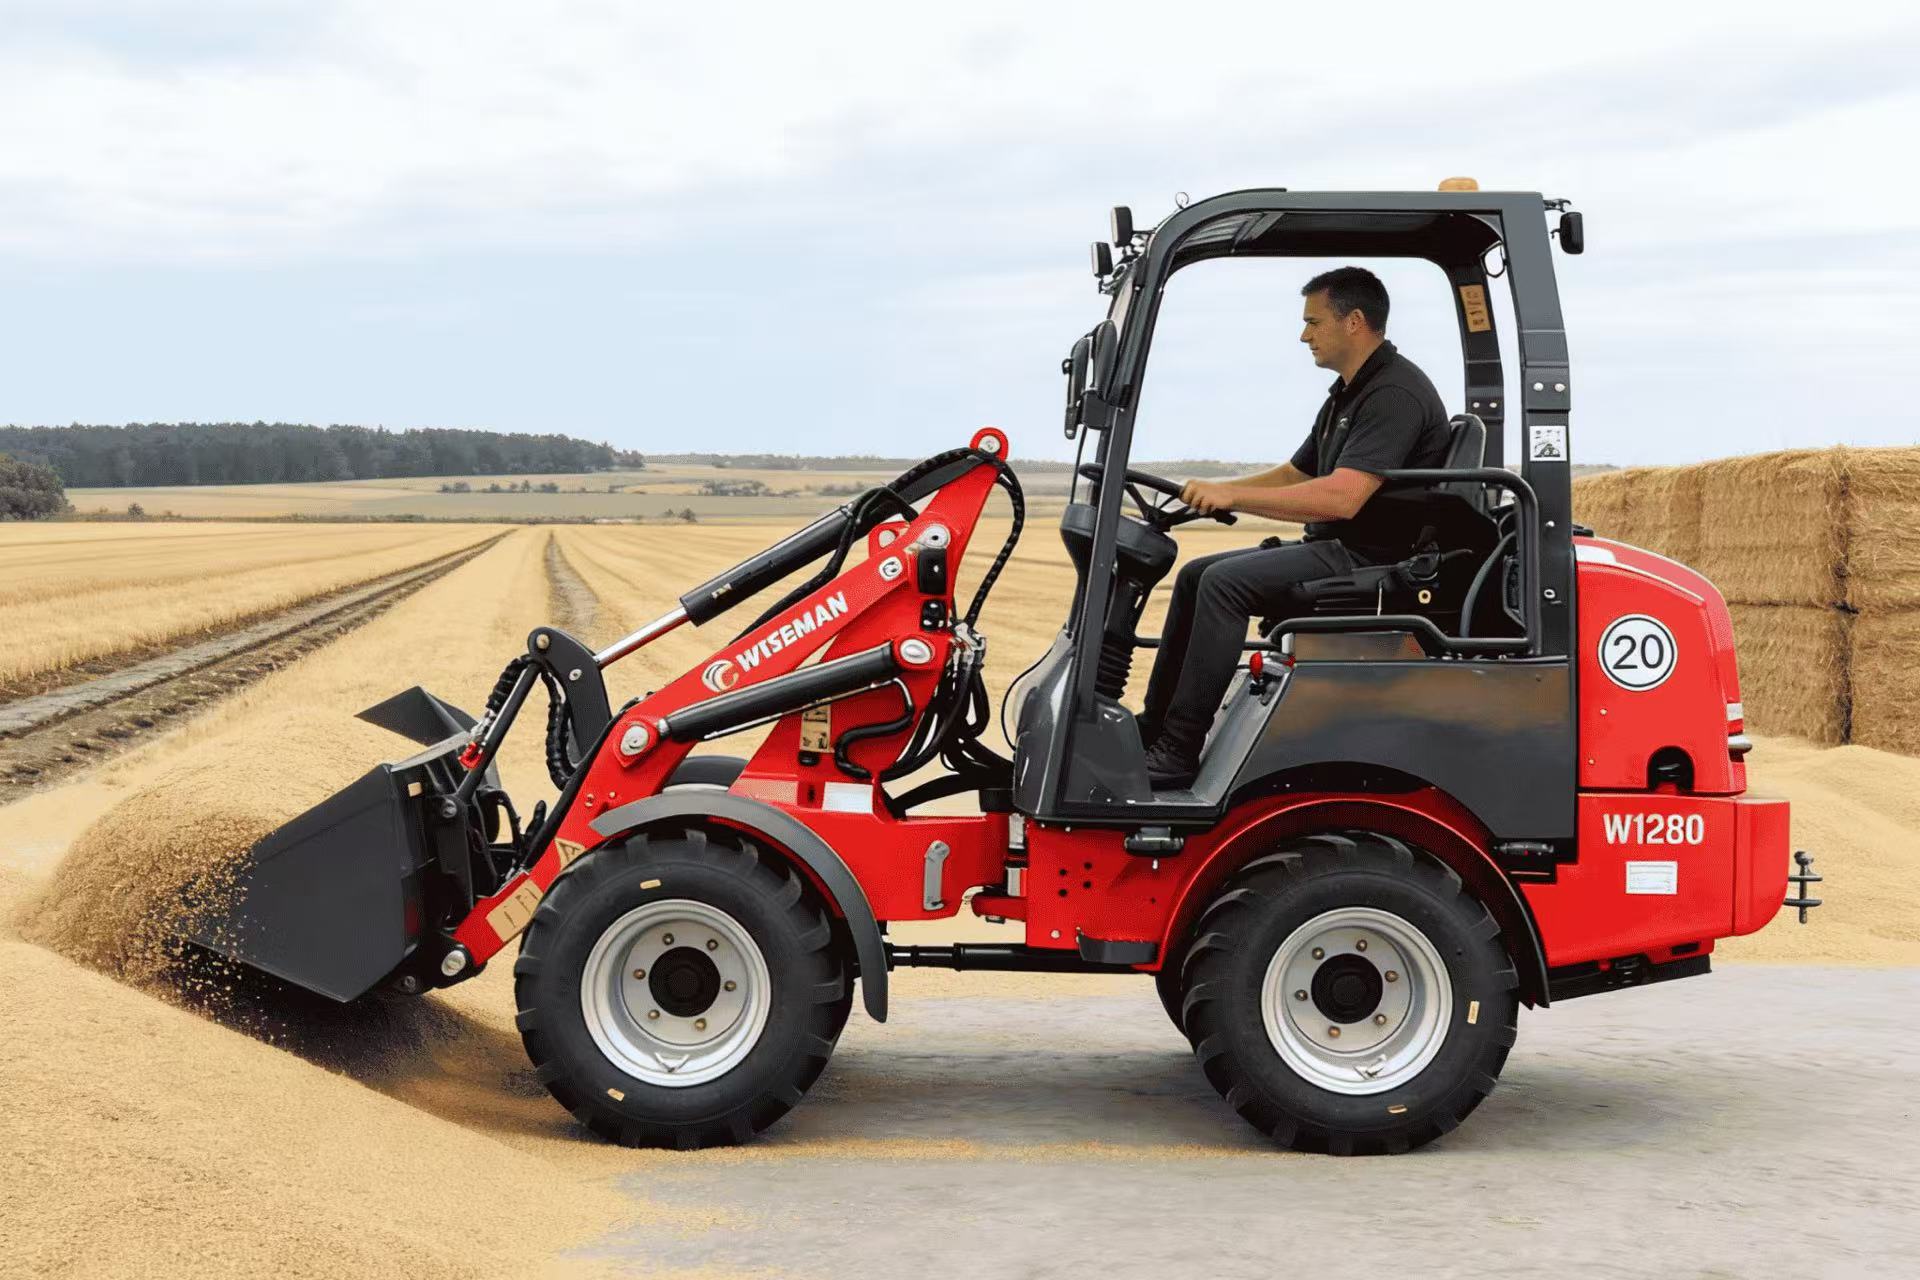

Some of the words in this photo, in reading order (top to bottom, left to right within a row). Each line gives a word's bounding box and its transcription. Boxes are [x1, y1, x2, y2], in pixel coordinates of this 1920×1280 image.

[736, 591, 848, 672] WISEMAN
[1612, 634, 1664, 669] 20
[1603, 813, 1704, 844] W1280
